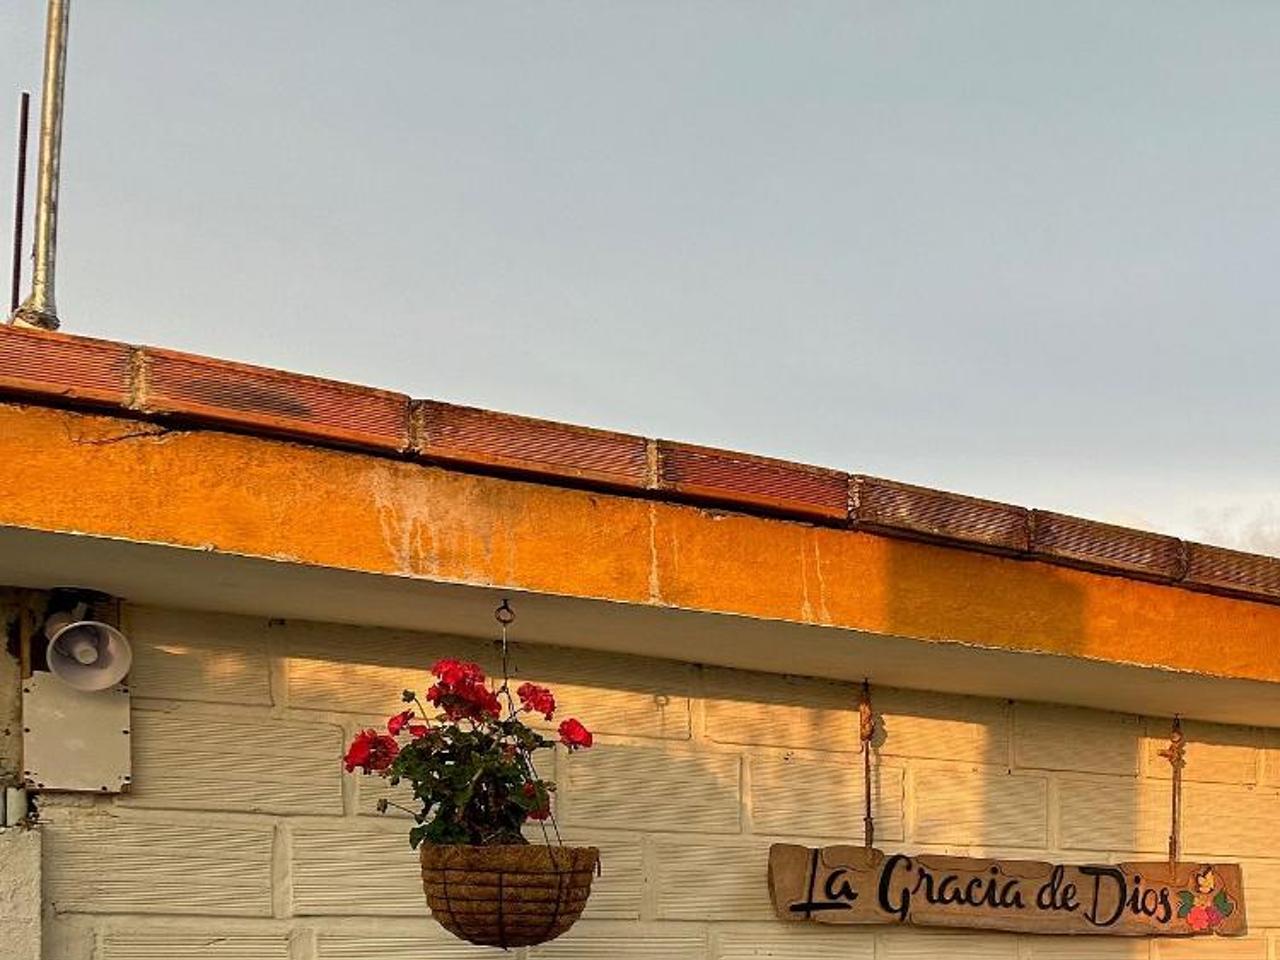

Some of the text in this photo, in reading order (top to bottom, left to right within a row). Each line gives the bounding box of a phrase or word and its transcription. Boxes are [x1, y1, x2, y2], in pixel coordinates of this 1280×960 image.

[789, 848, 1173, 927] La Gracia de Dios
